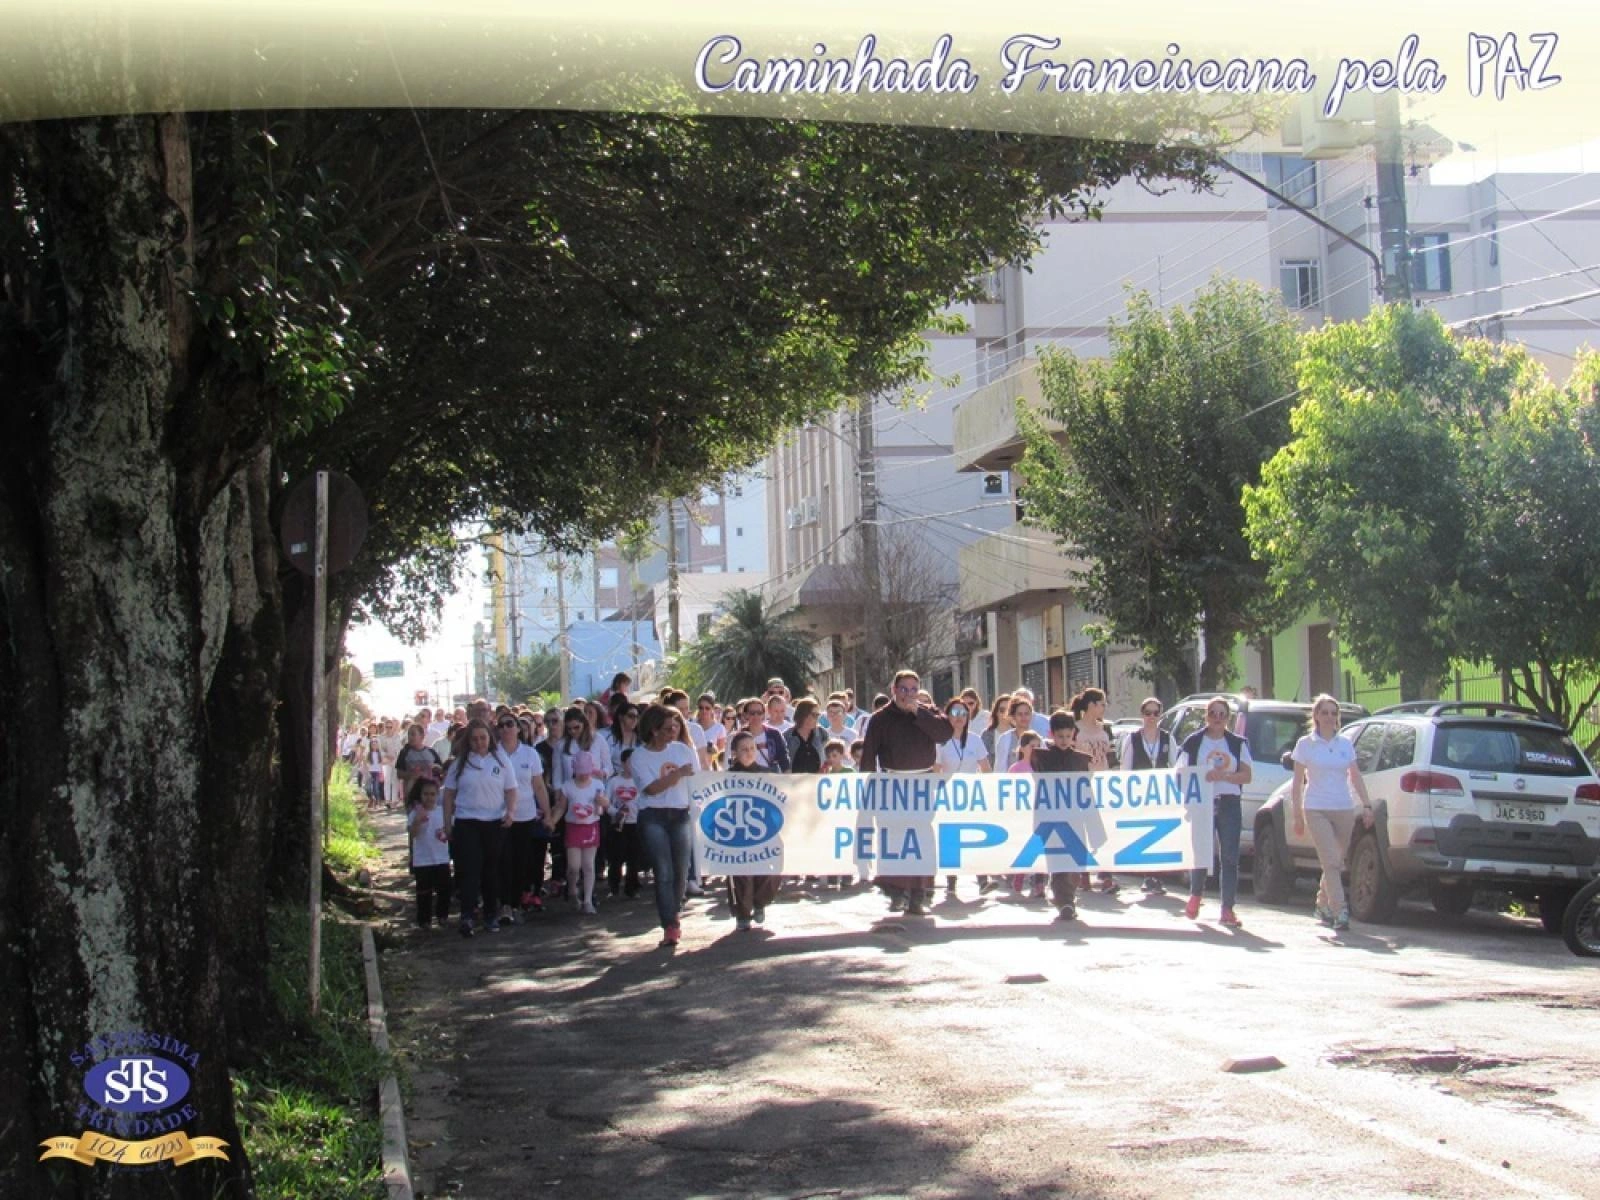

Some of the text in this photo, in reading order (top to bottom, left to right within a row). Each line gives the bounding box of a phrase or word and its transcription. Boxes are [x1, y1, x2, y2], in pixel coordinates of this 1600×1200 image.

[691, 774, 788, 804] Santíssima
[816, 771, 1203, 812] CAMINHADA FRANCISCANA
[714, 797, 768, 841] STS
[703, 845, 781, 865] Trindade
[834, 818, 1184, 869] PELA PAZ
